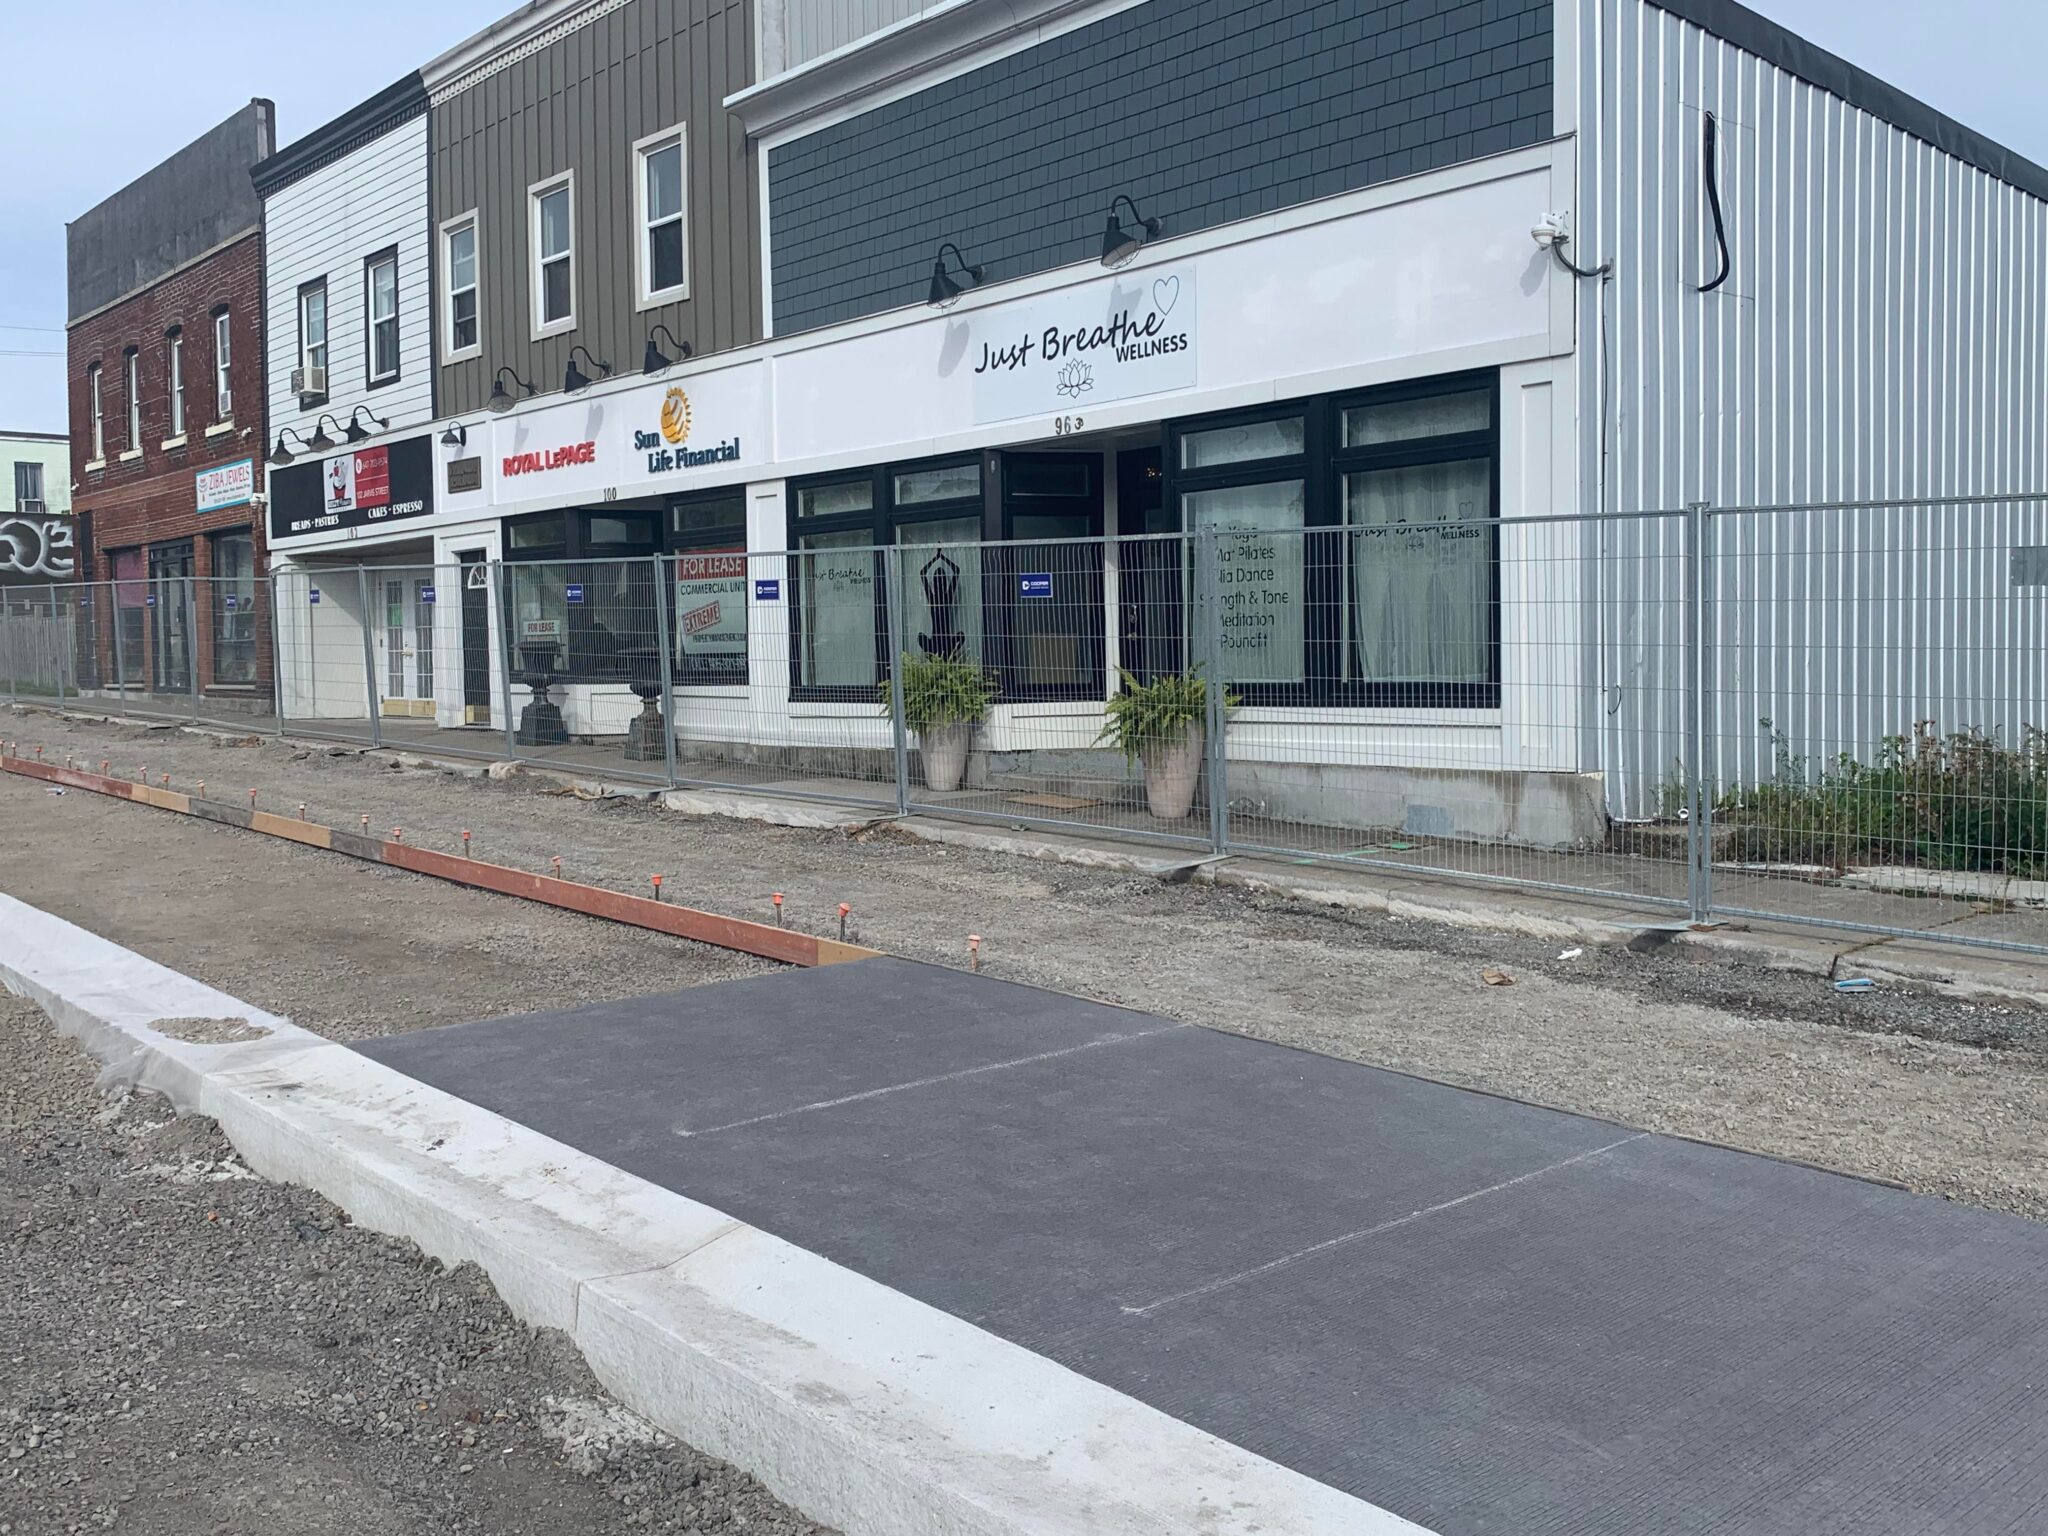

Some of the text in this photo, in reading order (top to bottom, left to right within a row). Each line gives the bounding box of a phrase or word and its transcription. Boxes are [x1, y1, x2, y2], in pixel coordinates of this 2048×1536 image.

[974, 309, 1165, 374] Just Breathe
[1116, 333, 1188, 363] WELLNESS
[634, 430, 660, 450] Sun
[648, 437, 740, 473] Life Financial
[502, 451, 545, 478] ROYAL
[209, 471, 225, 491] ZIBA
[225, 465, 250, 487] JEWELS
[375, 485, 389, 496] STREET
[603, 487, 617, 502] 100
[367, 500, 423, 519] CAKES ESPRESSO
[314, 514, 339, 528] PASTRIES
[1440, 529, 1480, 540] WELLNESS
[1238, 545, 1275, 560] Pilates
[682, 556, 742, 575] FOR LEASE
[1236, 567, 1274, 582] Dance
[681, 582, 728, 596] COMMERCIAL
[1249, 590, 1258, 605] &
[1261, 589, 1288, 604] Tone
[539, 622, 555, 633] LEASE
[685, 605, 720, 633] EXTREME
